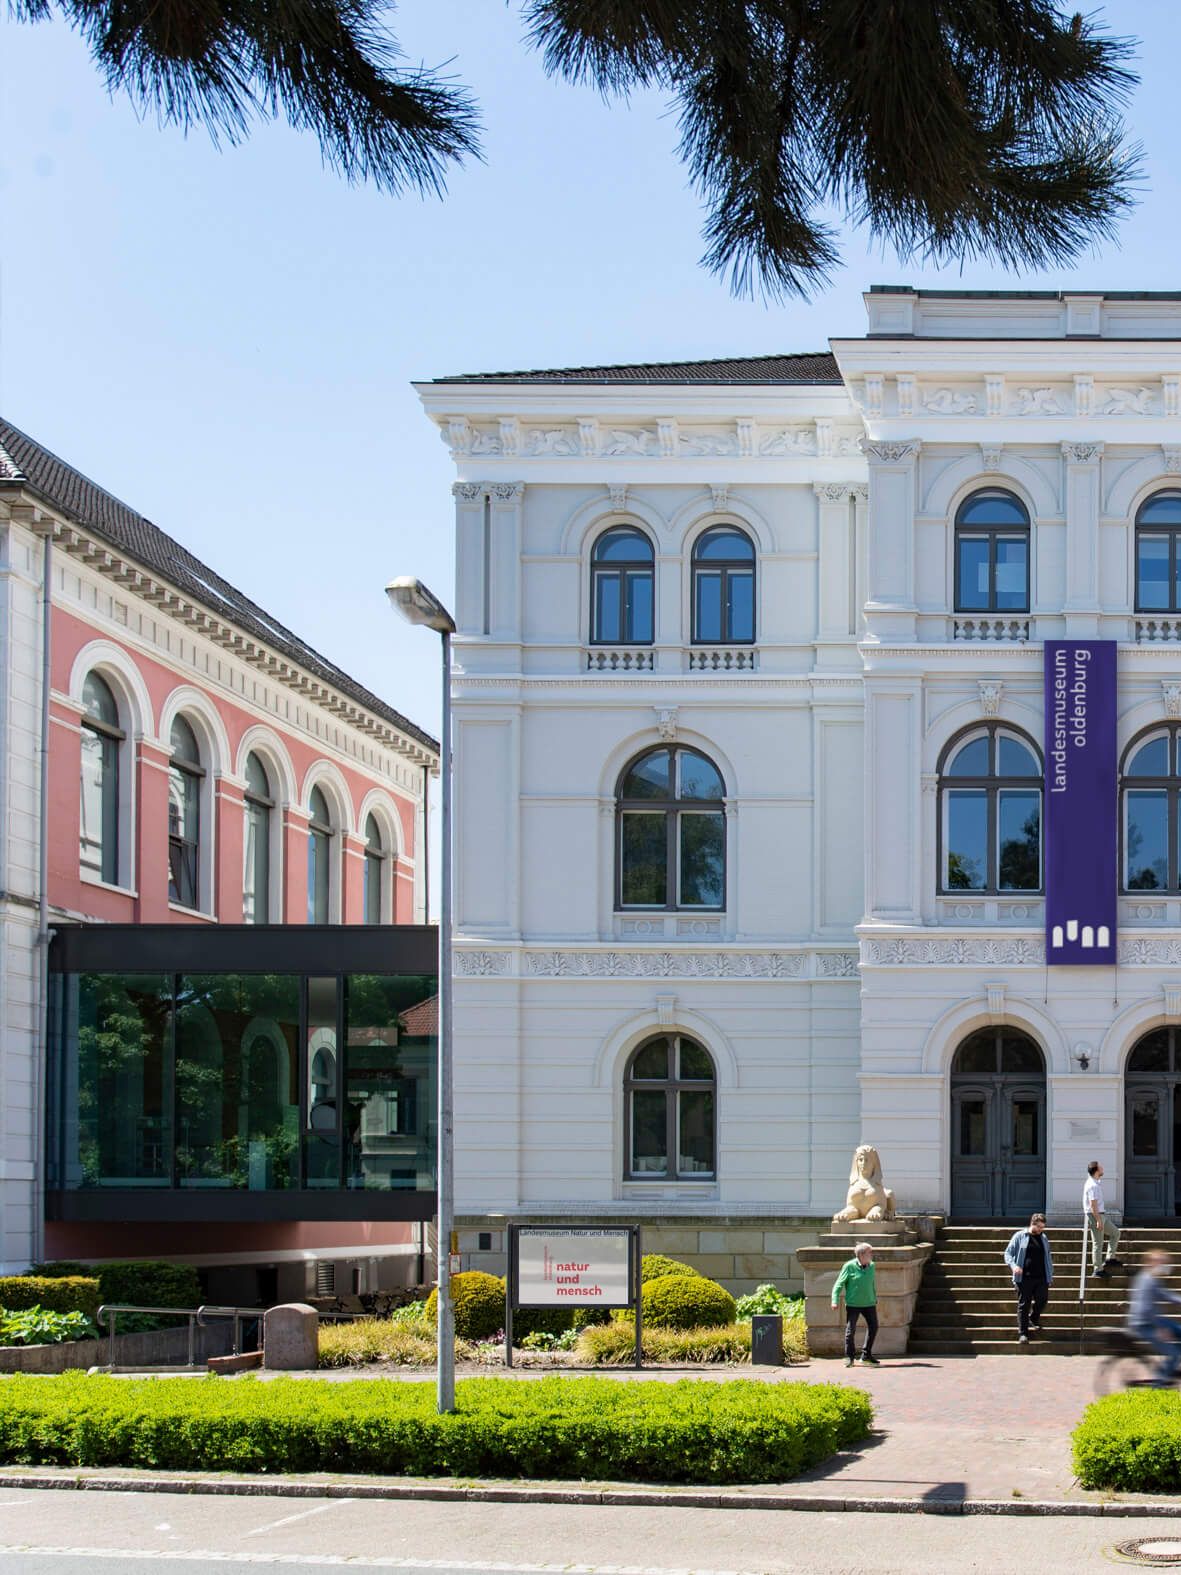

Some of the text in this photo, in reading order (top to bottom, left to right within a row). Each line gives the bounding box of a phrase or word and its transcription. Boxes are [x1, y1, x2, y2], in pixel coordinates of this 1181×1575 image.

[1069, 649, 1091, 748] oldenburg
[1051, 649, 1067, 793] landesmuseum
[556, 1261, 590, 1272] natur
[556, 1273, 580, 1285] und
[556, 1285, 602, 1297] mensch
